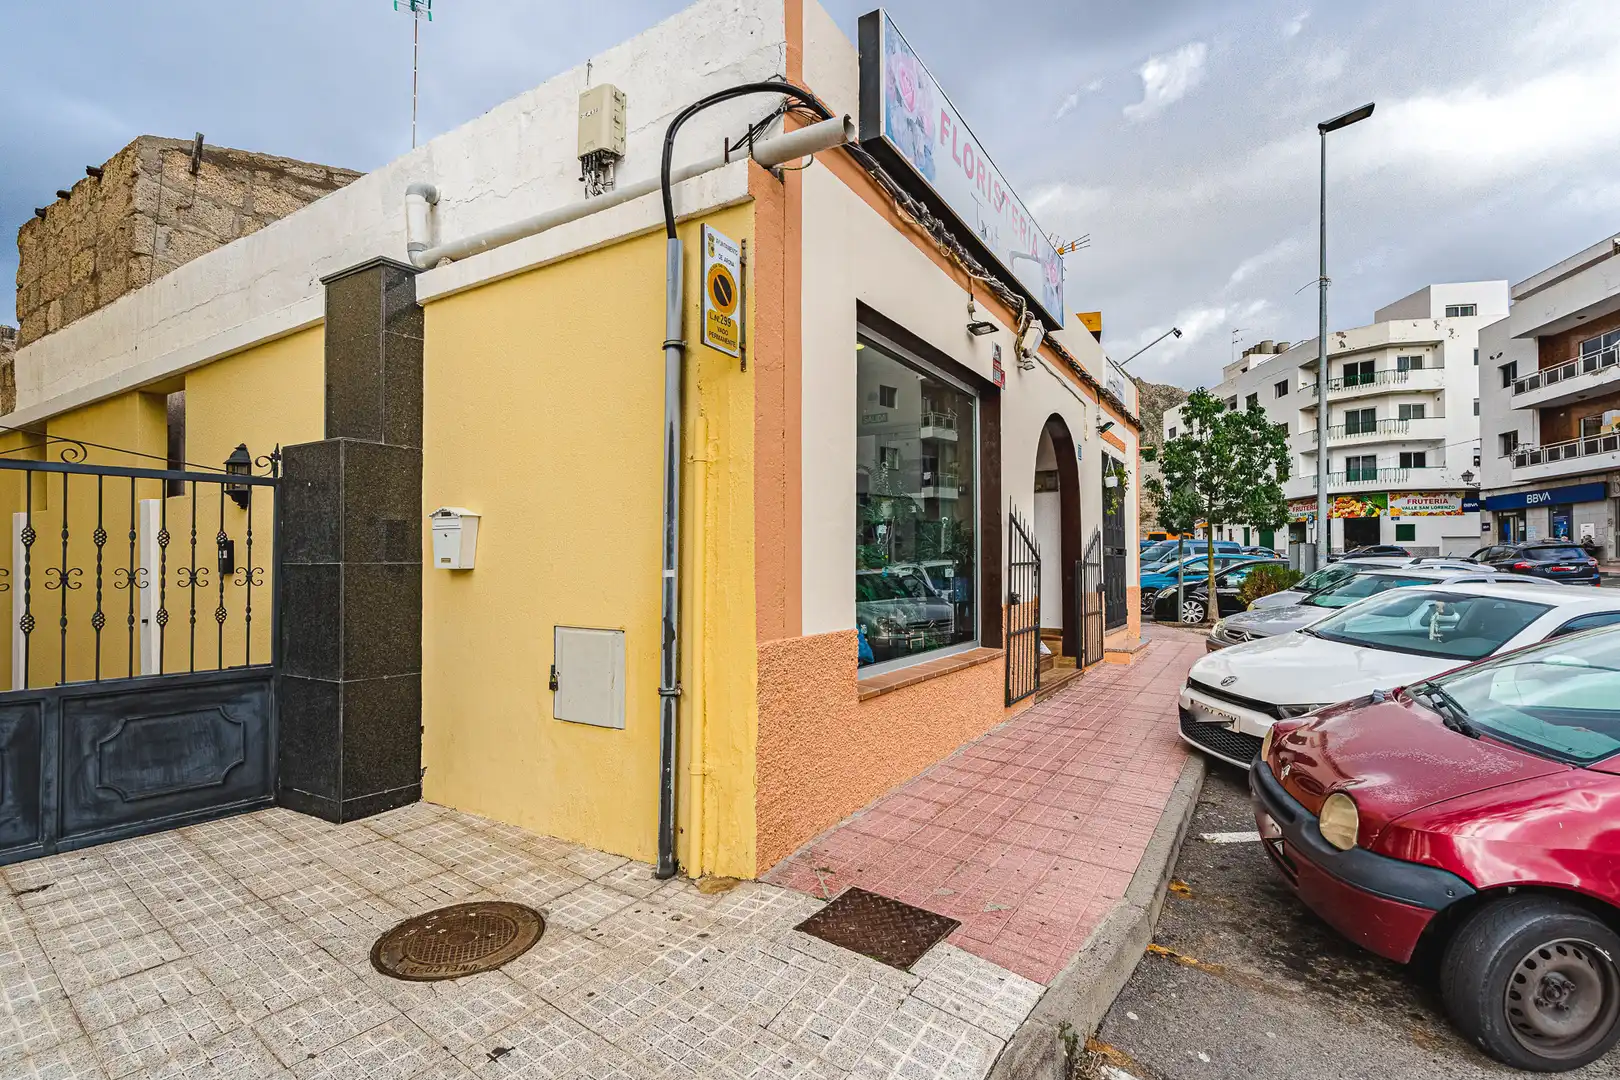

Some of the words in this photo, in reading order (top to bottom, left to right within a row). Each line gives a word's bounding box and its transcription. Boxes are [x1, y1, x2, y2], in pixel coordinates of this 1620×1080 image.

[940, 108, 1040, 260] FLORISTERÍA
[717, 325, 729, 337] VADO
[709, 330, 736, 348] PERMANENTE
[1526, 491, 1551, 504] BBVA
